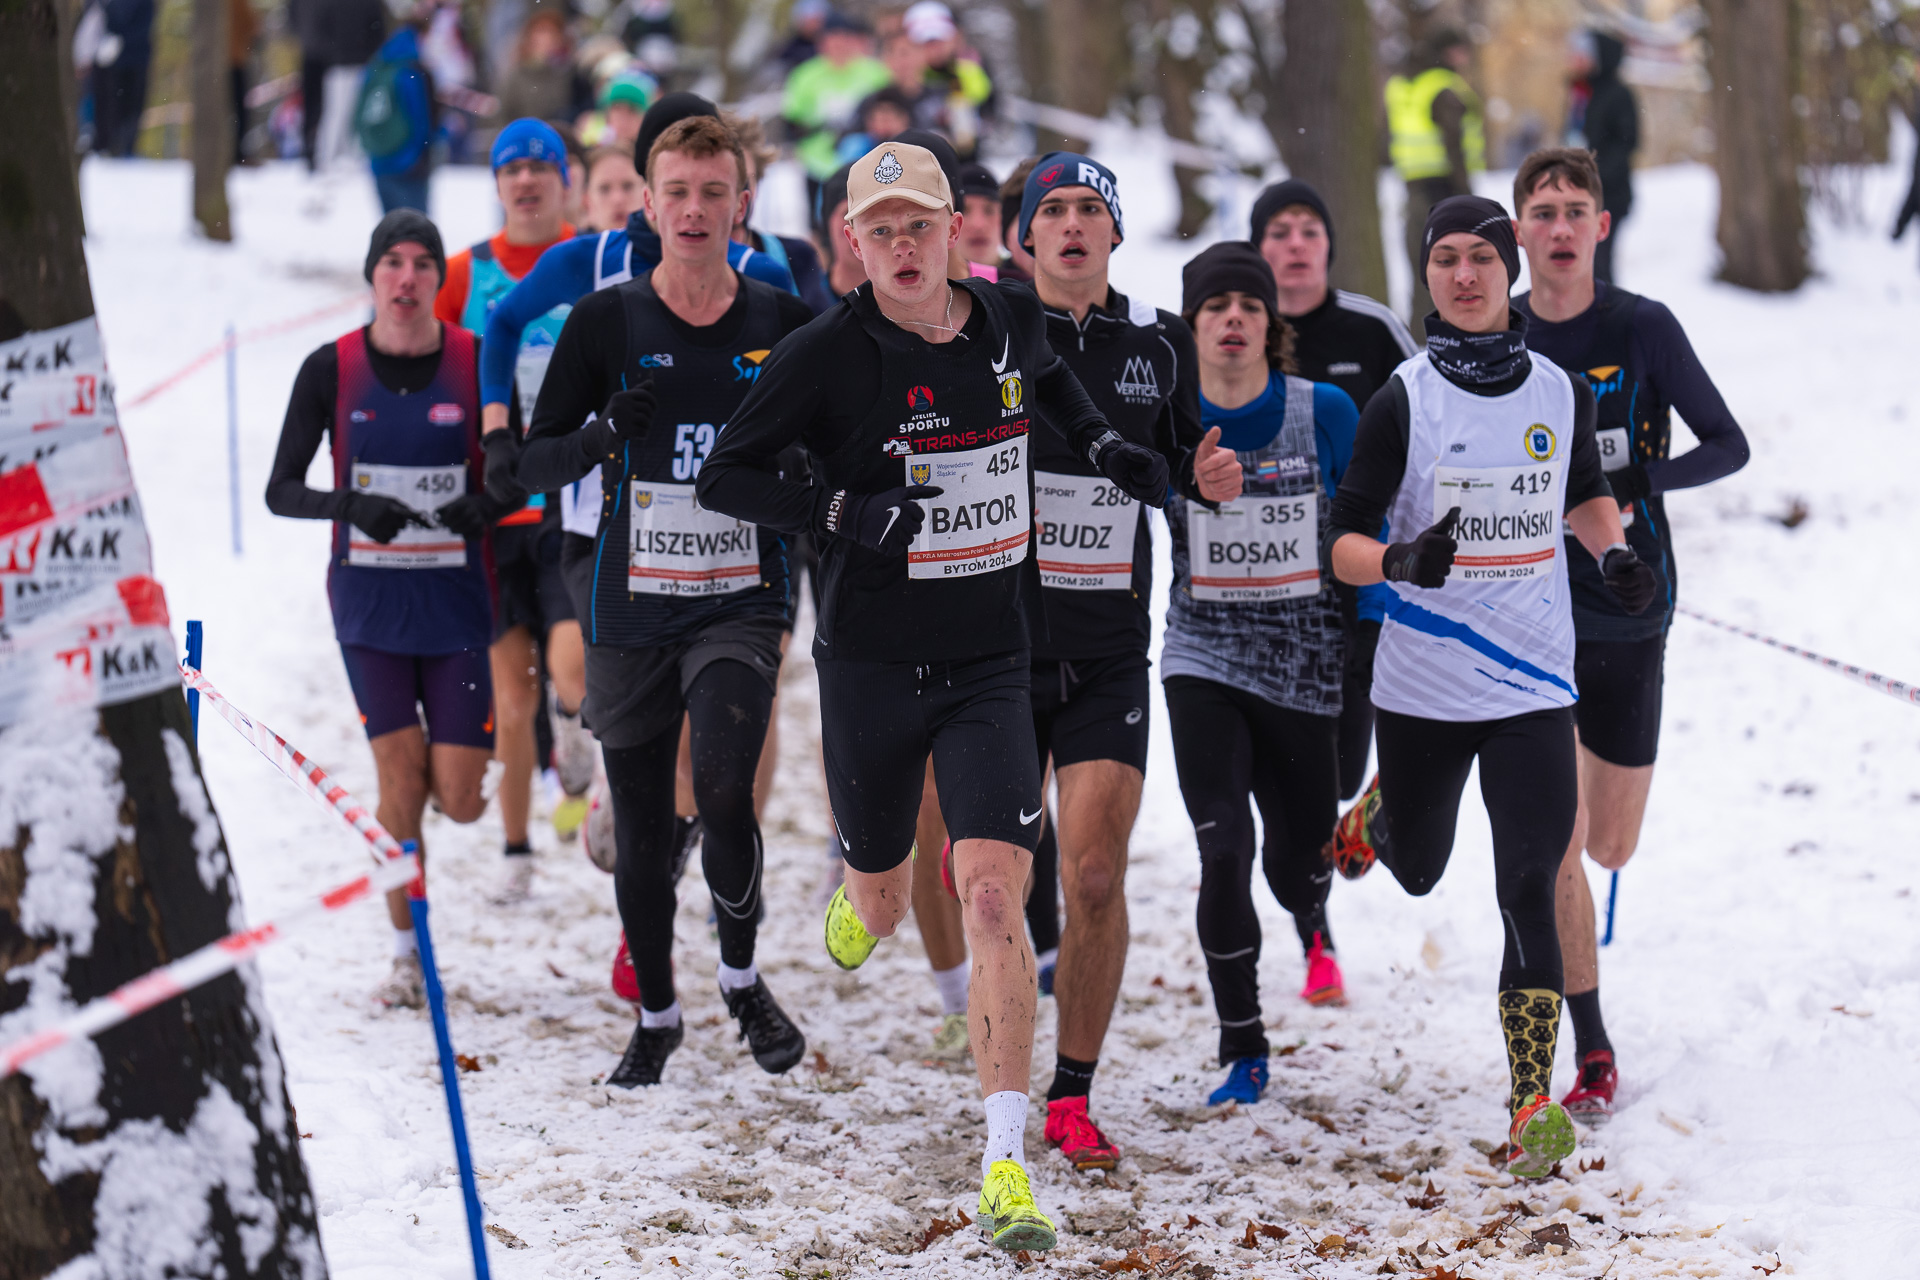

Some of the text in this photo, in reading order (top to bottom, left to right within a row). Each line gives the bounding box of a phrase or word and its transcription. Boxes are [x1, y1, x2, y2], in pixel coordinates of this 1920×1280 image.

[639, 353, 674, 368] esa
[1113, 381, 1161, 399] VERTICAL
[911, 412, 937, 421] ATELIER
[1001, 404, 1024, 418] BIEGA
[899, 417, 950, 434] SPORTU
[914, 418, 1030, 453] TRANS-KRUSZ
[672, 423, 728, 481] 53
[986, 446, 1020, 477] 452
[936, 461, 974, 471] Województwo
[415, 472, 456, 494] 450
[1044, 487, 1077, 498] SPORT
[1510, 470, 1552, 495] 419
[1091, 485, 1132, 507] 288
[931, 494, 1018, 534] BATOR
[1262, 502, 1305, 524] 355
[635, 527, 751, 556] LISZEWSKI
[1040, 521, 1113, 550] BUDZ
[970, 546, 985, 555] Polski
[1209, 538, 1299, 564] BOSAK
[944, 553, 1013, 575] BYTOM 2024
[1464, 567, 1535, 579] BYTOM 2024
[660, 581, 730, 593] BYTOM 2024
[1079, 577, 1104, 586] 2024
[1221, 586, 1291, 599] BYTOM 2024
